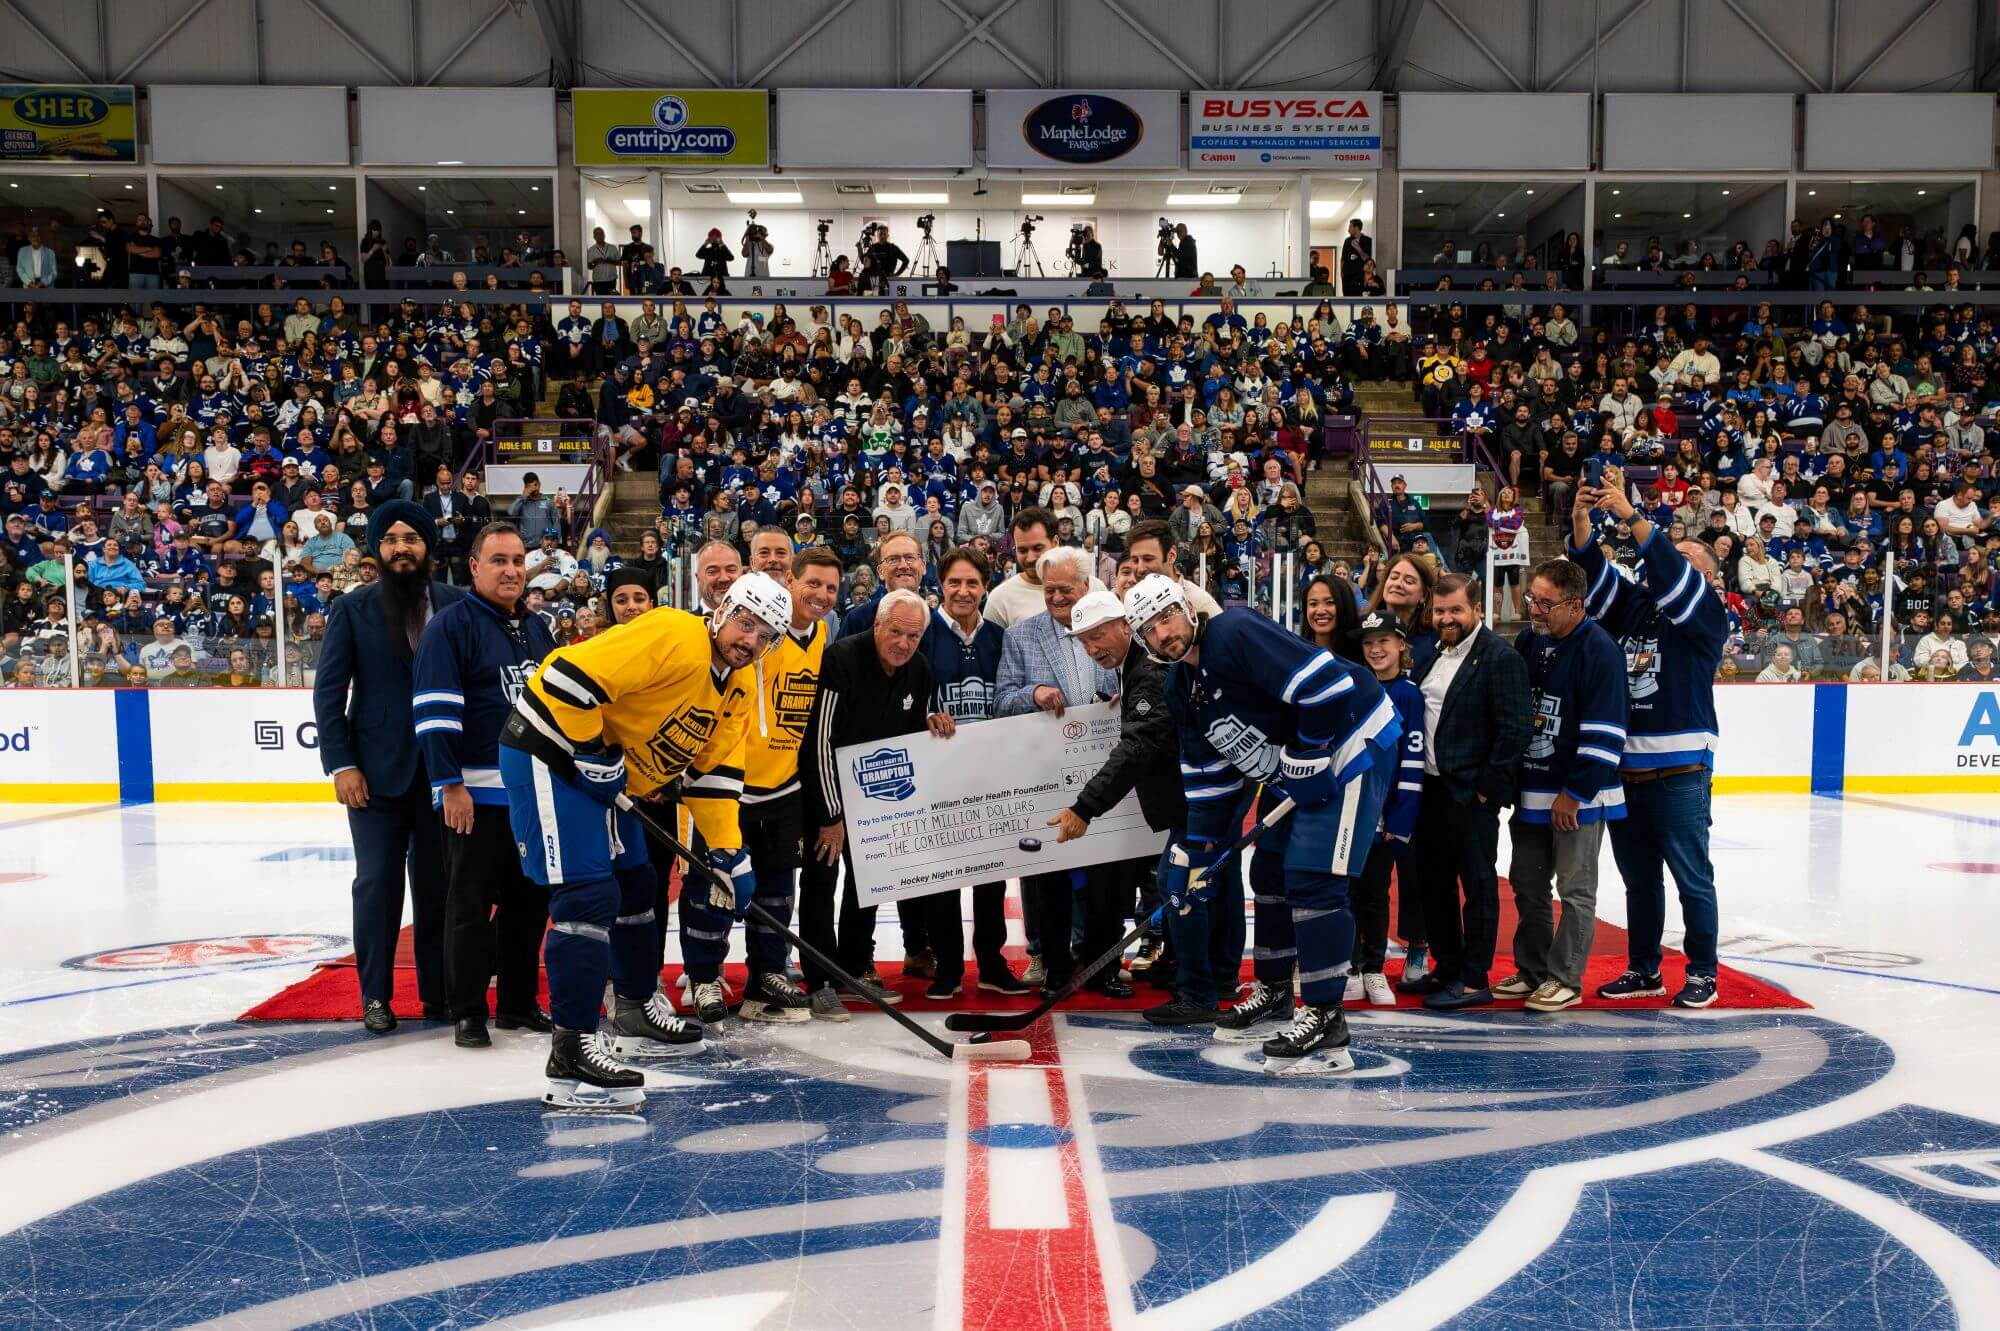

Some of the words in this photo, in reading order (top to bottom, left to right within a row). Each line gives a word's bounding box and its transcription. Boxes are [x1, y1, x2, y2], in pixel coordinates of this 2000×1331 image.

[24, 97, 95, 120] SHER
[1203, 100, 1369, 118] BUSYS.CA
[1202, 124, 1284, 132] BUSINESS
[1292, 124, 1370, 132] SYSTEMS
[615, 130, 727, 151] entripy.com
[1068, 141, 1099, 151] FARMS
[1201, 153, 1236, 162] Canon
[499, 442, 520, 450] AISLE
[542, 442, 548, 450] 3
[559, 442, 579, 450] AISLE
[1370, 441, 1390, 449] AISLE
[1412, 440, 1418, 448] 4
[1429, 440, 1449, 449] AISLE
[1451, 440, 1461, 448] 4L
[1907, 600, 1930, 610] HOC
[781, 695, 816, 710] BRAMPT
[1408, 731, 1424, 753] 3
[862, 764, 911, 784] BRAMPTON
[1283, 763, 1315, 775] RIOR
[857, 818, 870, 827] Pay
[881, 814, 893, 822] the
[895, 810, 915, 819] Order
[916, 808, 927, 816] of:
[931, 799, 960, 811] William
[963, 795, 983, 805] Osler
[986, 790, 1012, 801] Health
[1013, 783, 1059, 796] Foundation
[891, 818, 927, 837] FIFTY
[932, 809, 980, 829] MILLION
[986, 800, 1035, 818] DOLLARS
[860, 833, 892, 844] Amount:
[888, 840, 910, 858] THE
[914, 825, 983, 851] CORTELLUCCI
[989, 817, 1031, 839] FAMILY
[547, 835, 556, 868] CCM
[865, 852, 887, 861] From:
[900, 874, 930, 886] Hockey
[931, 870, 953, 880] Night
[955, 867, 963, 875] in
[964, 860, 1004, 874] Brampton
[871, 884, 896, 894] Memo:
